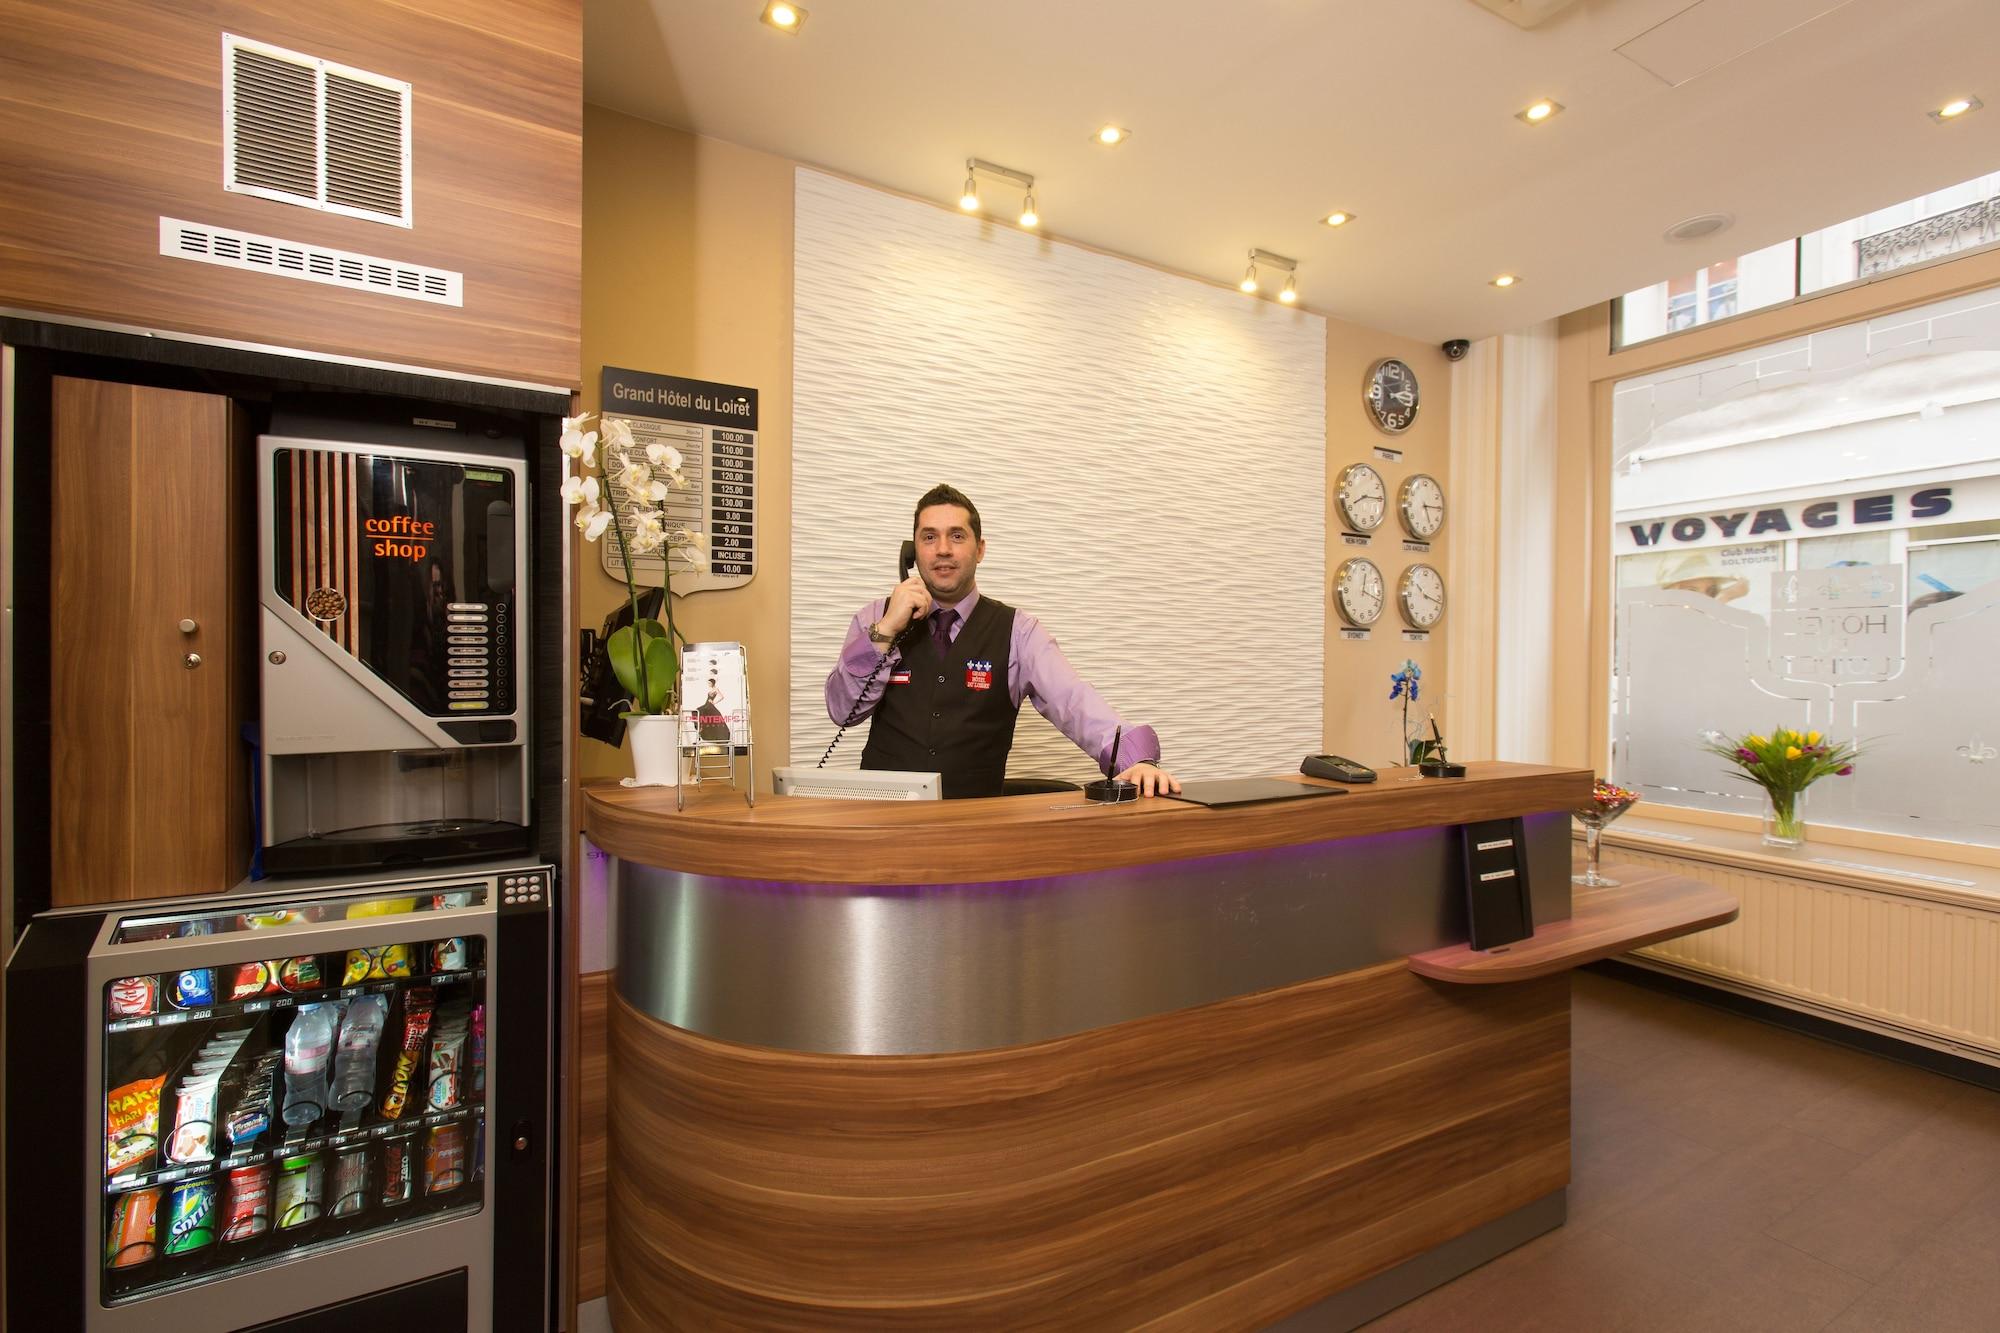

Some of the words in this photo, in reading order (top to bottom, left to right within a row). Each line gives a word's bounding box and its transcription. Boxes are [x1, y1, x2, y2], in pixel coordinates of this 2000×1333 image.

[1388, 363, 1399, 379] 12
[1373, 384, 1381, 400] 9
[613, 383, 654, 403] Grand
[658, 389, 692, 408] Hôtel
[695, 395, 711, 411] du
[715, 397, 751, 417] Loiret
[1380, 411, 1387, 421] 7
[1404, 407, 1411, 418] 4
[1387, 413, 1397, 428] 6
[1398, 415, 1404, 426] 5
[721, 432, 744, 442] 100.00
[721, 445, 744, 456] 110.00
[721, 458, 744, 469] 100.00
[721, 472, 743, 482] 120.00
[721, 485, 743, 495] 125.00
[721, 498, 743, 508] 130.00
[725, 512, 741, 521] 9.00
[1630, 488, 1953, 546] VOYAGES
[366, 516, 434, 535] coffee
[724, 538, 739, 547] 2.00
[375, 539, 426, 562] shop
[717, 551, 746, 560] INCLUSE
[1721, 548, 1742, 557] Club
[722, 564, 741, 573] 10.00
[378, 1127, 387, 1135] 26
[400, 1155, 409, 1181] zero
